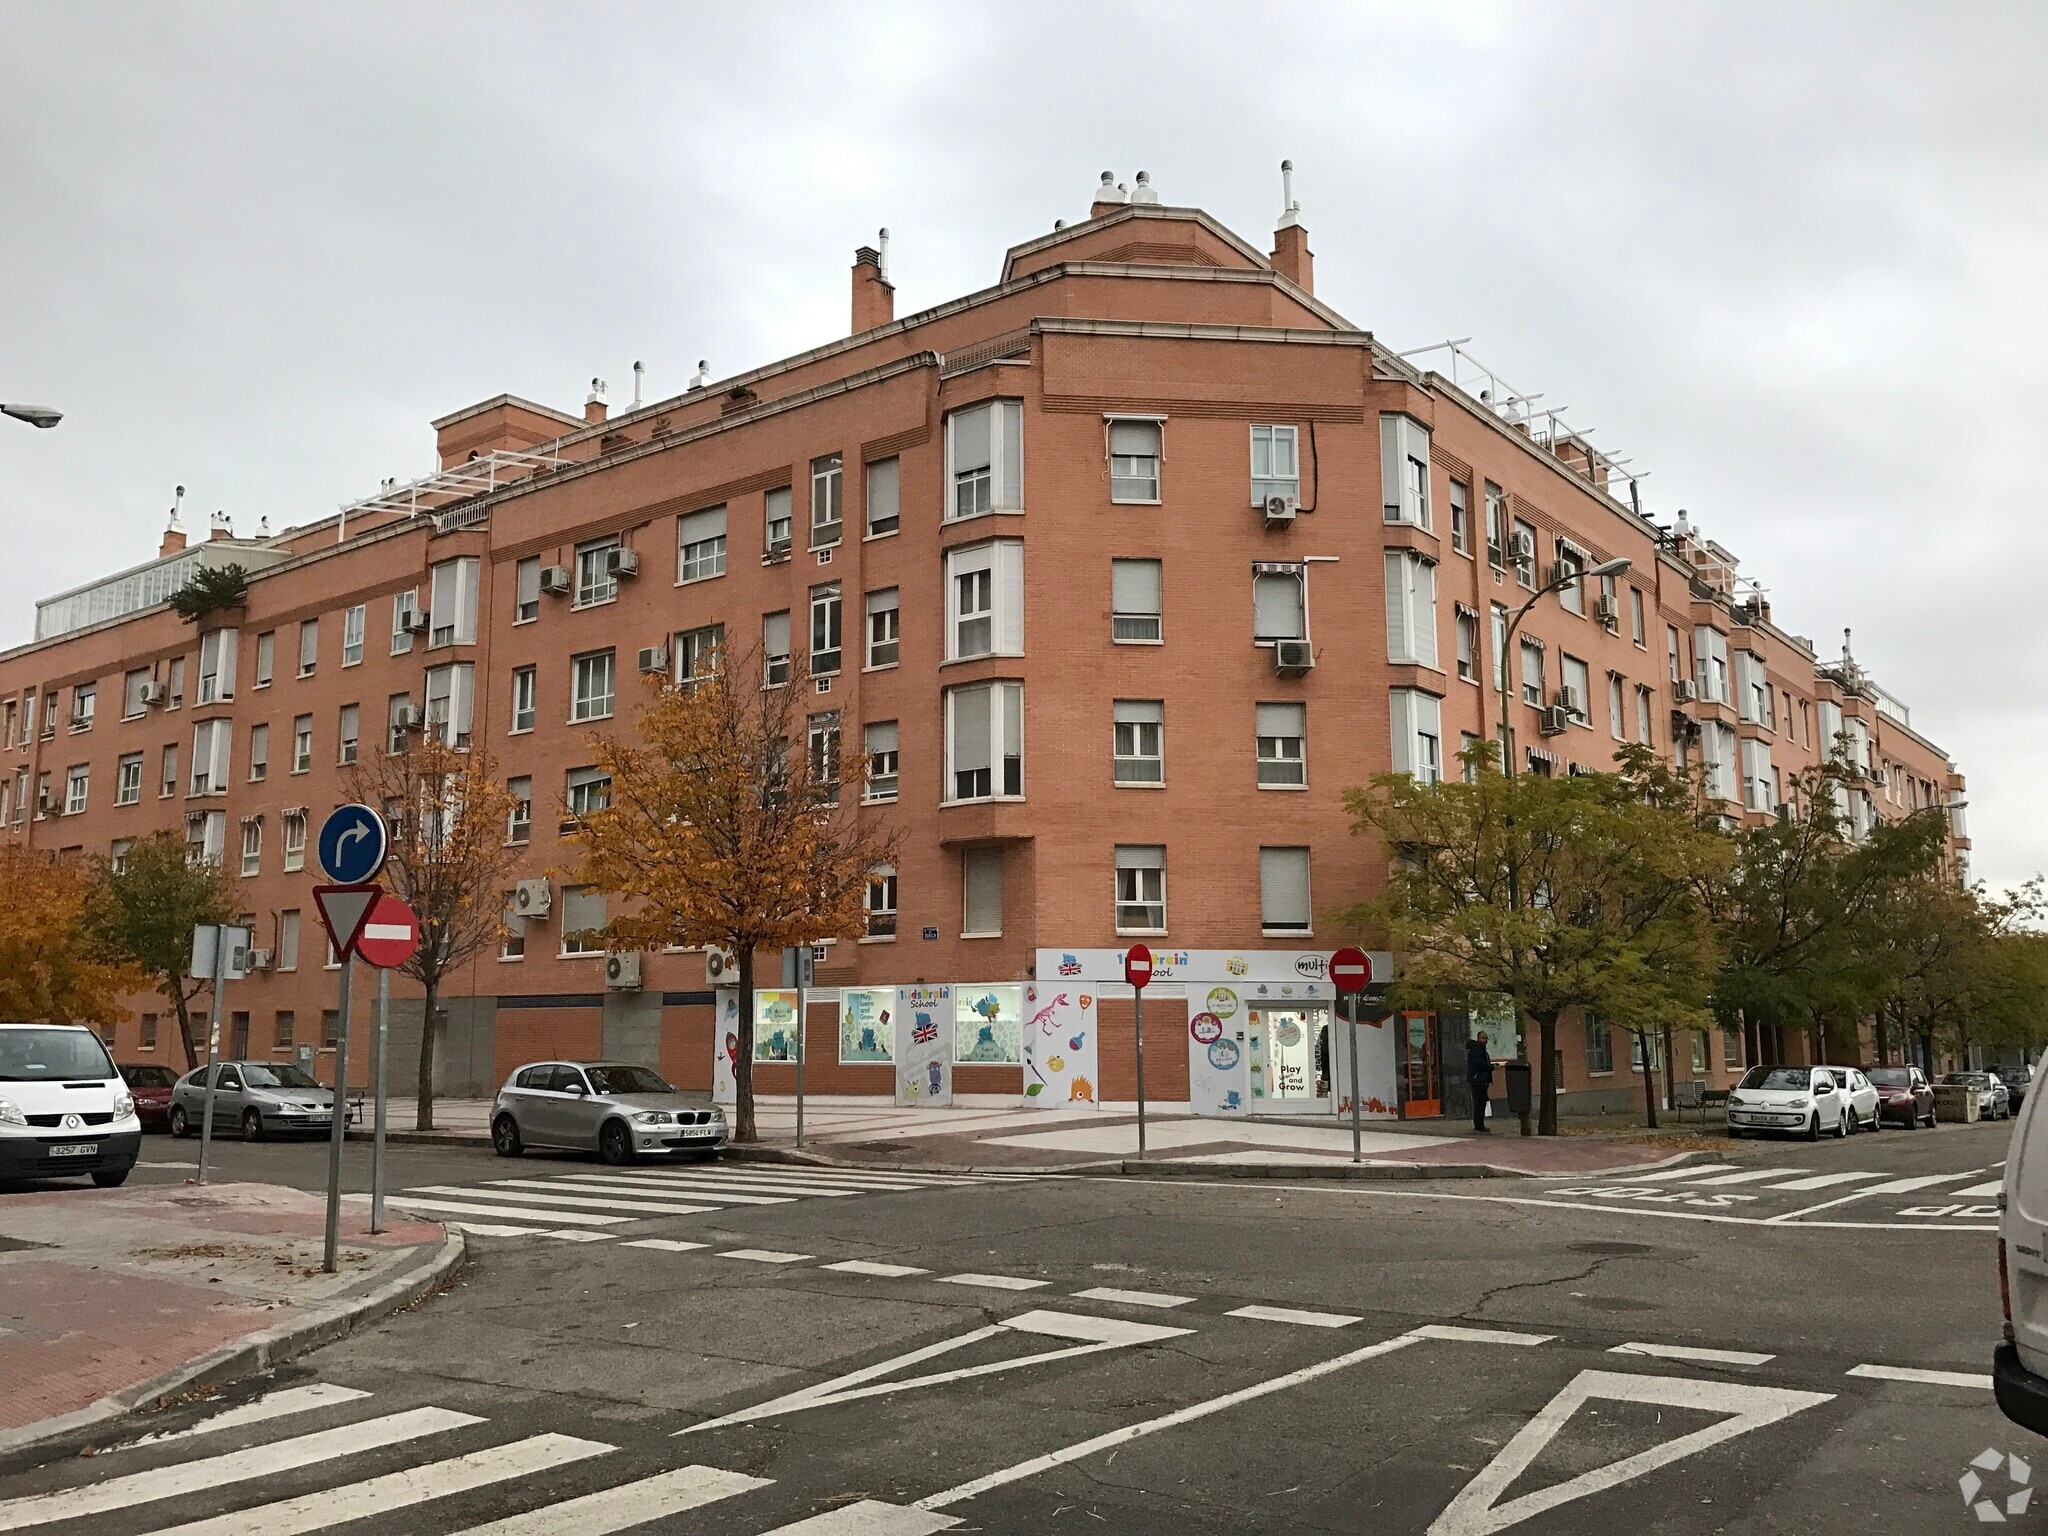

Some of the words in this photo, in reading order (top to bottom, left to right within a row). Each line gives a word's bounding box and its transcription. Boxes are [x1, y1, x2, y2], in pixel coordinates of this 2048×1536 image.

[910, 999, 939, 1009] School
[860, 1013, 875, 1021] Grow
[1280, 1065, 1301, 1075] Play
[1279, 1082, 1304, 1091] Grow
[55, 1146, 76, 1155] 3257
[80, 1145, 96, 1154] GVN
[1543, 1186, 1759, 1207] STOP
